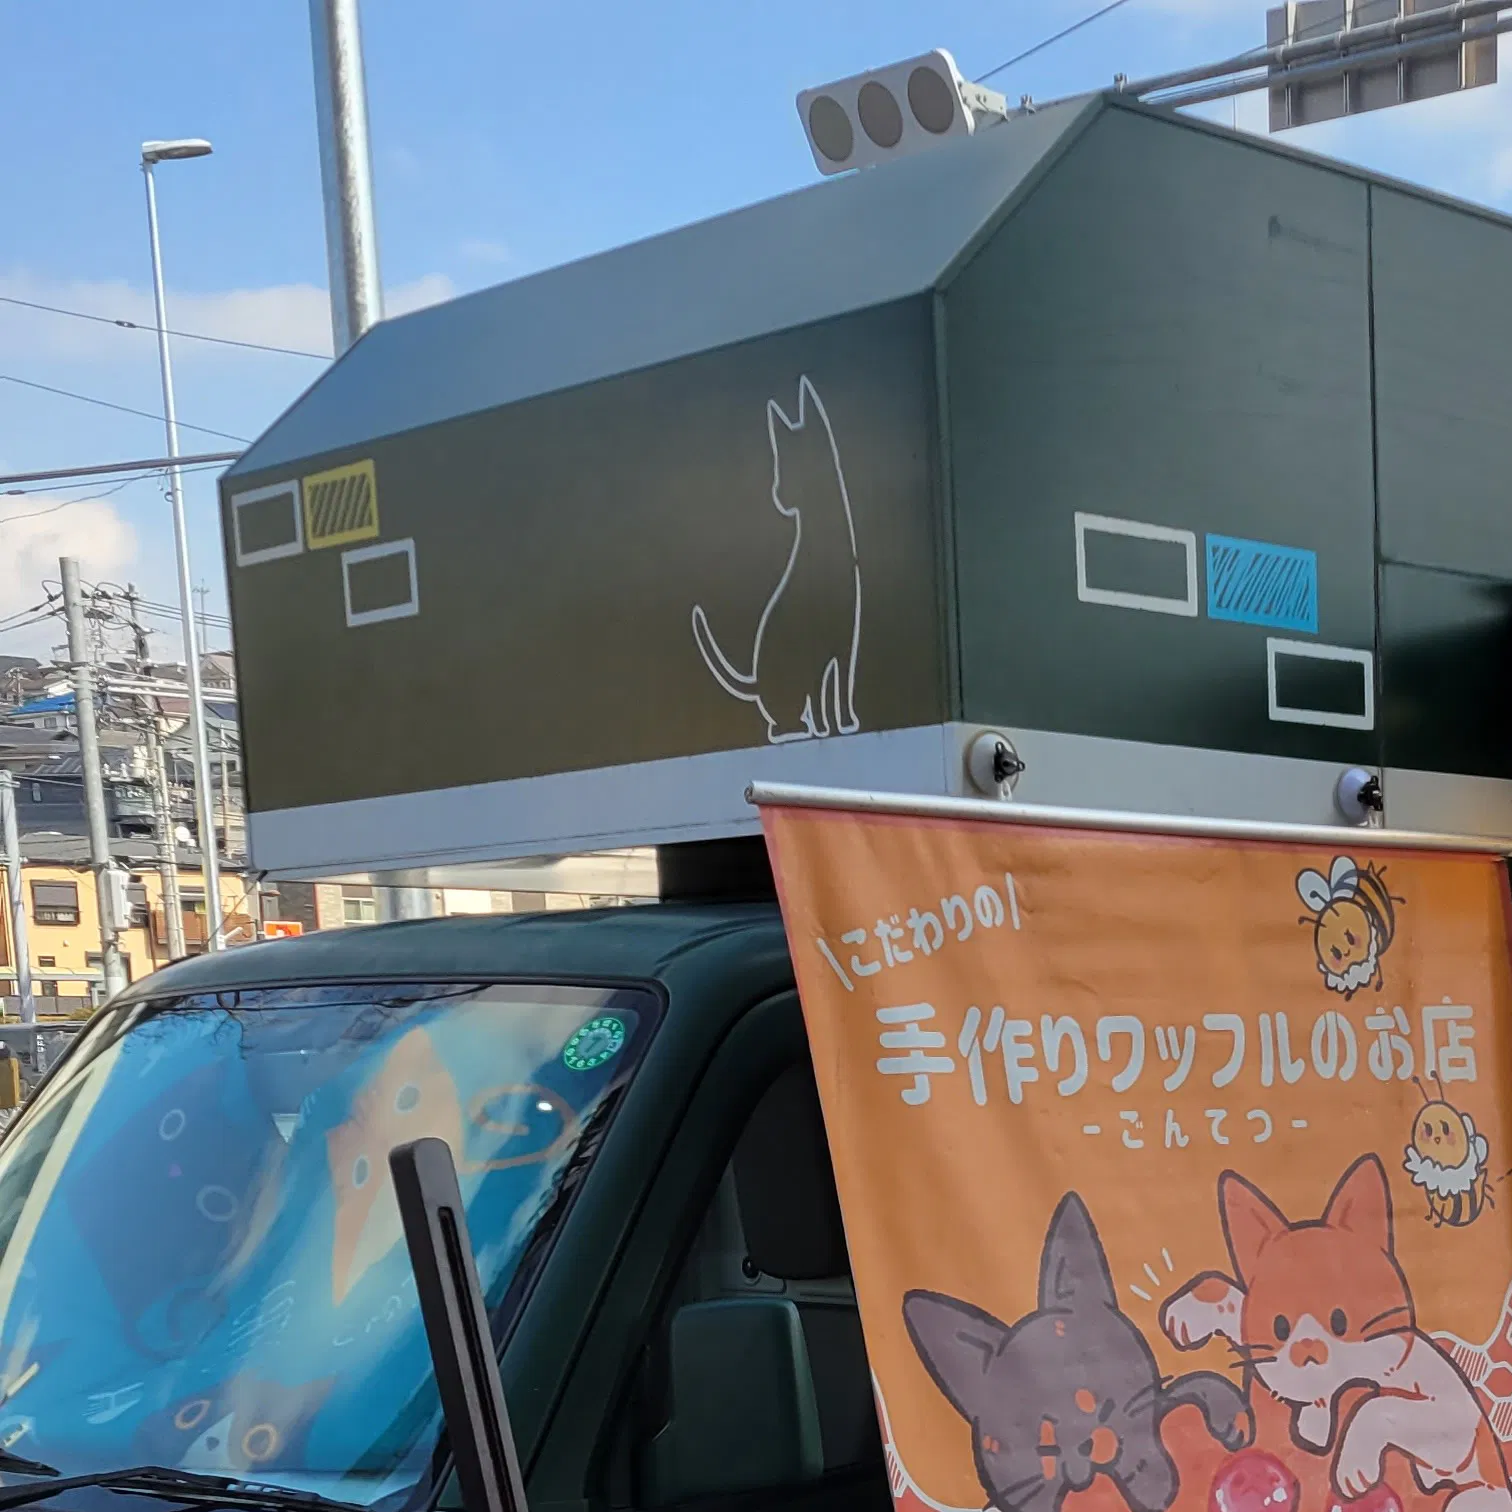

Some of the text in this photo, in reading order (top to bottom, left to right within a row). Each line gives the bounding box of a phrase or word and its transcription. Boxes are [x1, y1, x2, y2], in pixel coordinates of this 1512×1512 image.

[841, 884, 1004, 976] こだわりの
[876, 996, 1478, 1106] 手作りワッフルのお店
